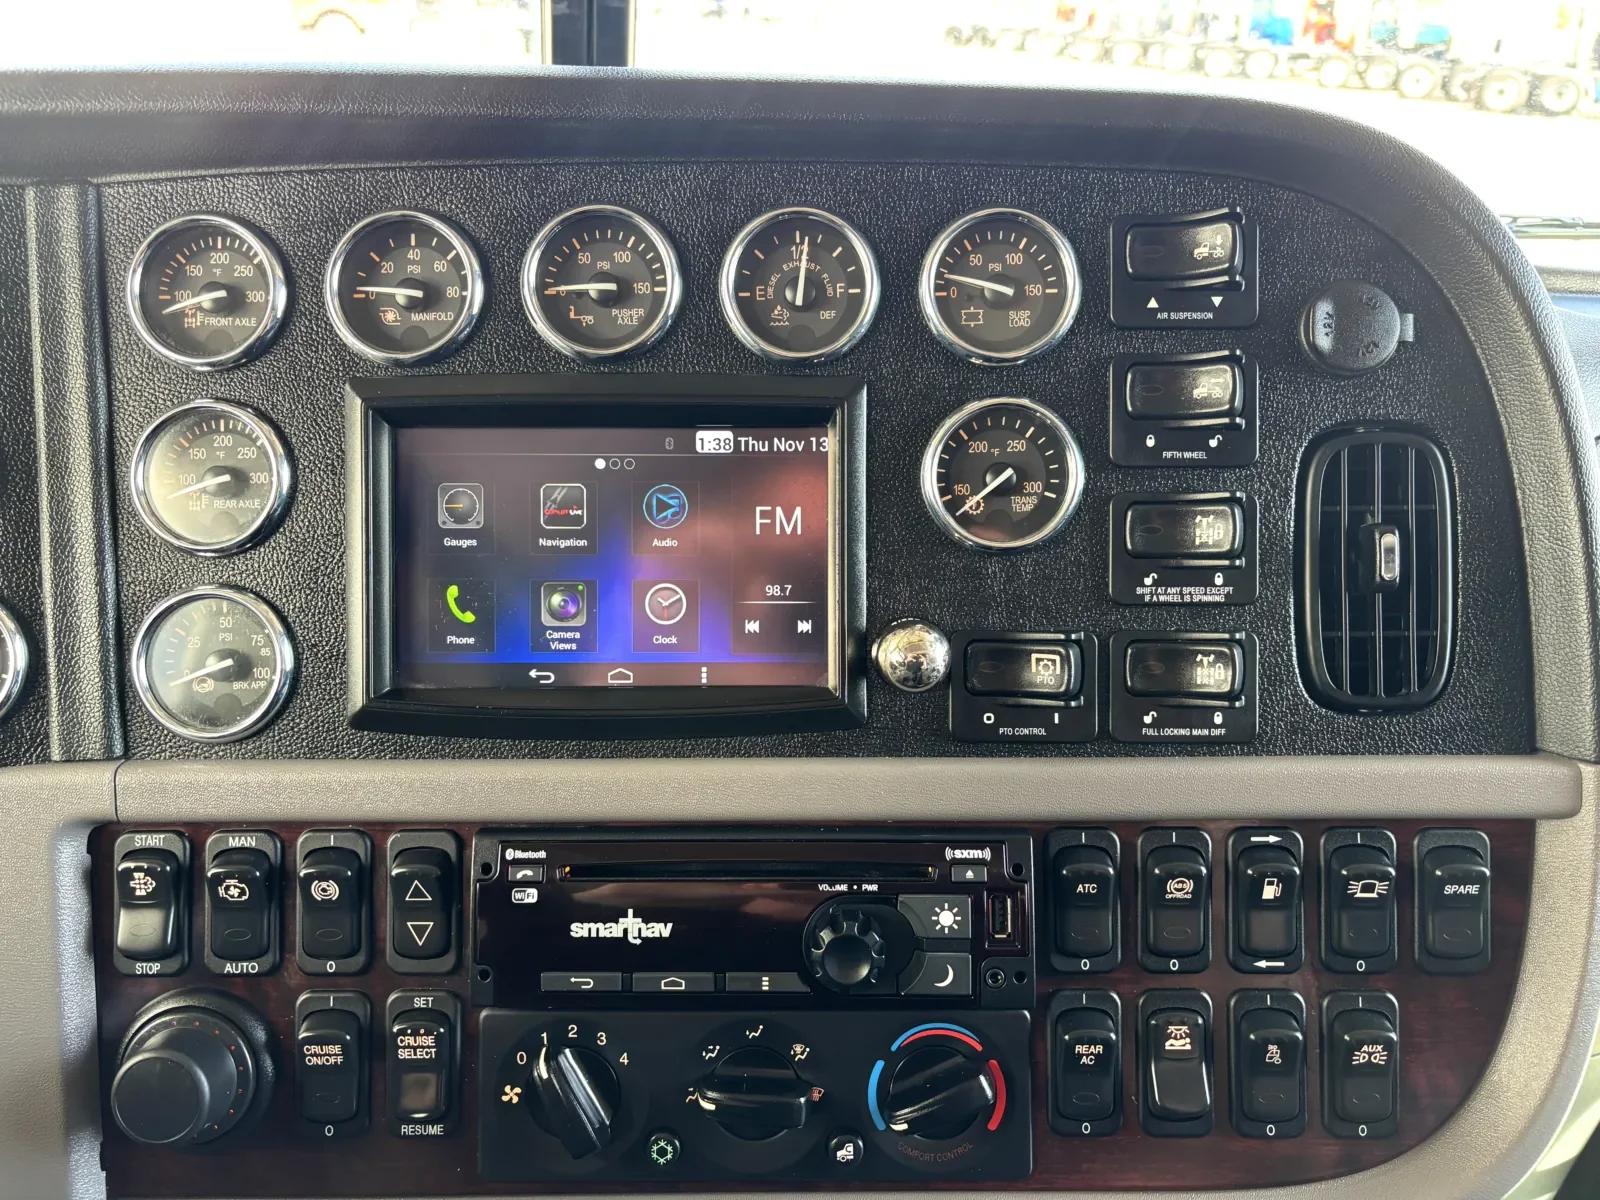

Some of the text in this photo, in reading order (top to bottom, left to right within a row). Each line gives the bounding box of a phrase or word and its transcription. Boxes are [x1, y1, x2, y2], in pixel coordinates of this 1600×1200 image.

[210, 252, 229, 264] 200
[407, 249, 420, 260] 40
[578, 252, 591, 264] 50
[613, 251, 631, 262] 100
[1005, 253, 1023, 264] 100
[597, 261, 610, 269] PSI
[970, 255, 982, 266] 50
[185, 265, 202, 276] 150
[234, 266, 253, 277] 250
[381, 262, 394, 273] 20
[407, 264, 421, 273] PSI
[433, 261, 447, 272] 60
[988, 263, 1002, 271] PSI
[633, 282, 650, 294] 150
[767, 272, 781, 299] DIESEL
[821, 273, 833, 296] FLUID
[174, 290, 192, 302] 100
[446, 286, 459, 297] 80
[756, 286, 765, 300] E
[836, 283, 845, 298] F
[950, 287, 957, 298] 0
[1024, 285, 1042, 296] 150
[245, 291, 265, 303] 300
[411, 312, 453, 321] MANIFOLD
[617, 316, 638, 324] AXLE
[820, 310, 837, 319] DEF
[1008, 311, 1030, 319] SUSP
[204, 318, 257, 326] FRONT AXLE
[1008, 318, 1030, 327] LOAD
[213, 436, 232, 447] 200
[698, 437, 828, 451] 1:38 Thu Nov 13
[968, 442, 988, 452] 200
[1007, 440, 1026, 451] 250
[190, 449, 206, 460] 150
[237, 448, 257, 459] 250
[179, 473, 196, 485] 100
[250, 472, 269, 484] 300
[953, 484, 970, 495] 150
[1023, 482, 1042, 493] 300
[214, 500, 261, 508] REAR AXLE
[1010, 496, 1038, 504] TRANS
[1012, 504, 1034, 512] TEMP
[755, 506, 801, 535] FM
[444, 538, 477, 547] Gauges
[539, 537, 587, 547] Navigation
[652, 538, 678, 547] Audio
[765, 585, 792, 596] 98.7
[219, 617, 232, 628] 50
[219, 632, 232, 641] PSI
[251, 634, 264, 646] 75
[447, 636, 475, 644] Phone
[546, 630, 580, 639] Camera
[653, 635, 678, 644] Clock
[550, 642, 577, 650] Views
[260, 648, 270, 656] 85
[253, 667, 270, 679] 100
[251, 680, 267, 689] APP
[1036, 676, 1054, 685] PTO
[135, 835, 165, 846] START
[229, 837, 256, 846] MAN
[514, 850, 546, 858] Bluetooth
[1076, 884, 1097, 893] ATC
[1444, 885, 1480, 894] SPARE
[570, 909, 673, 945] smartnav
[136, 963, 160, 974] STOP
[224, 962, 258, 973] AUTO
[414, 997, 433, 1008] SET
[568, 1025, 578, 1037] 2
[397, 1036, 436, 1046] CRUISE
[541, 1032, 547, 1045] 1
[597, 1032, 606, 1045] 3
[304, 1045, 342, 1054] CRUISE
[398, 1049, 436, 1059] SELECT
[1075, 1045, 1103, 1054] REAR
[306, 1056, 343, 1065] ON/OFF
[516, 1052, 527, 1064] 0
[619, 1052, 629, 1065] 4
[1080, 1056, 1095, 1065] AC
[401, 1124, 444, 1136] RESUME
[898, 1141, 974, 1162] COMFORT CONTROL
